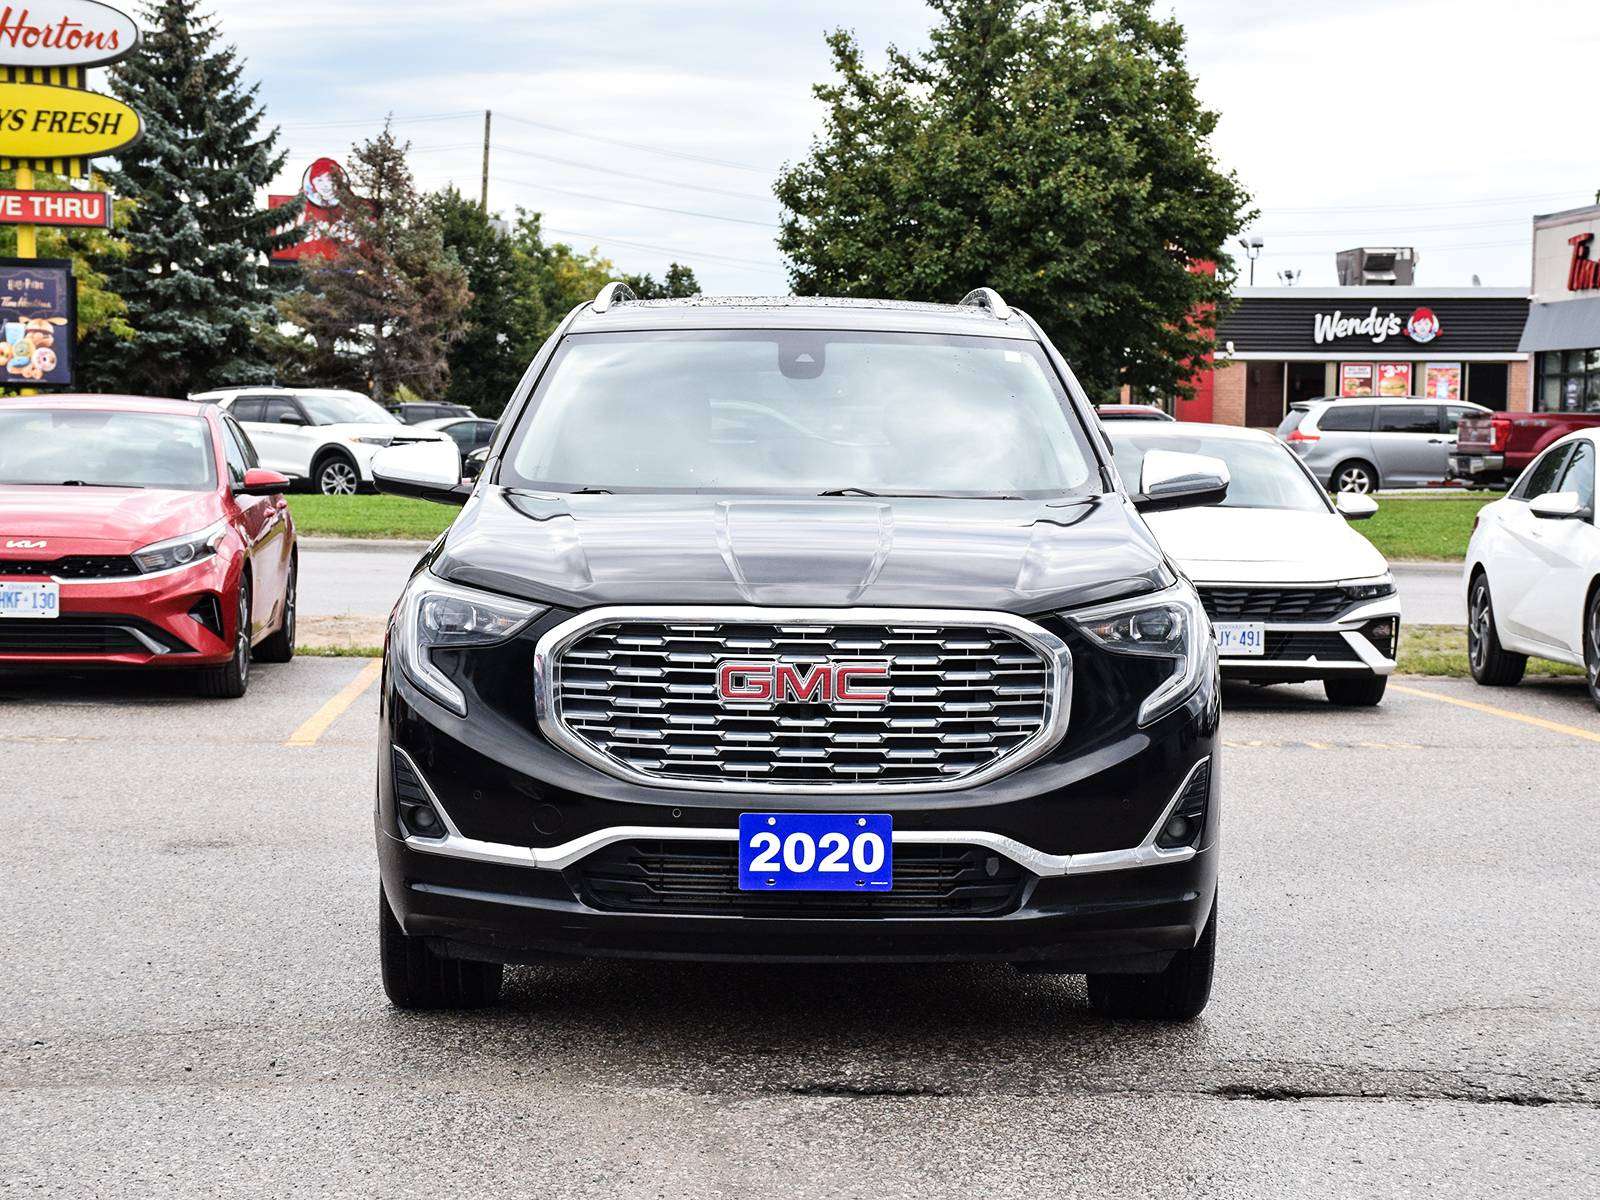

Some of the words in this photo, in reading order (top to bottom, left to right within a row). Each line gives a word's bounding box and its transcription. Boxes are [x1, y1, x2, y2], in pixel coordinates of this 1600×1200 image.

[0, 6, 119, 50] Hortons
[31, 110, 122, 135] FRESH
[28, 197, 100, 219] THRU
[1314, 306, 1401, 344] Wendy's
[717, 661, 891, 703] GMC
[749, 832, 885, 873] 2020
